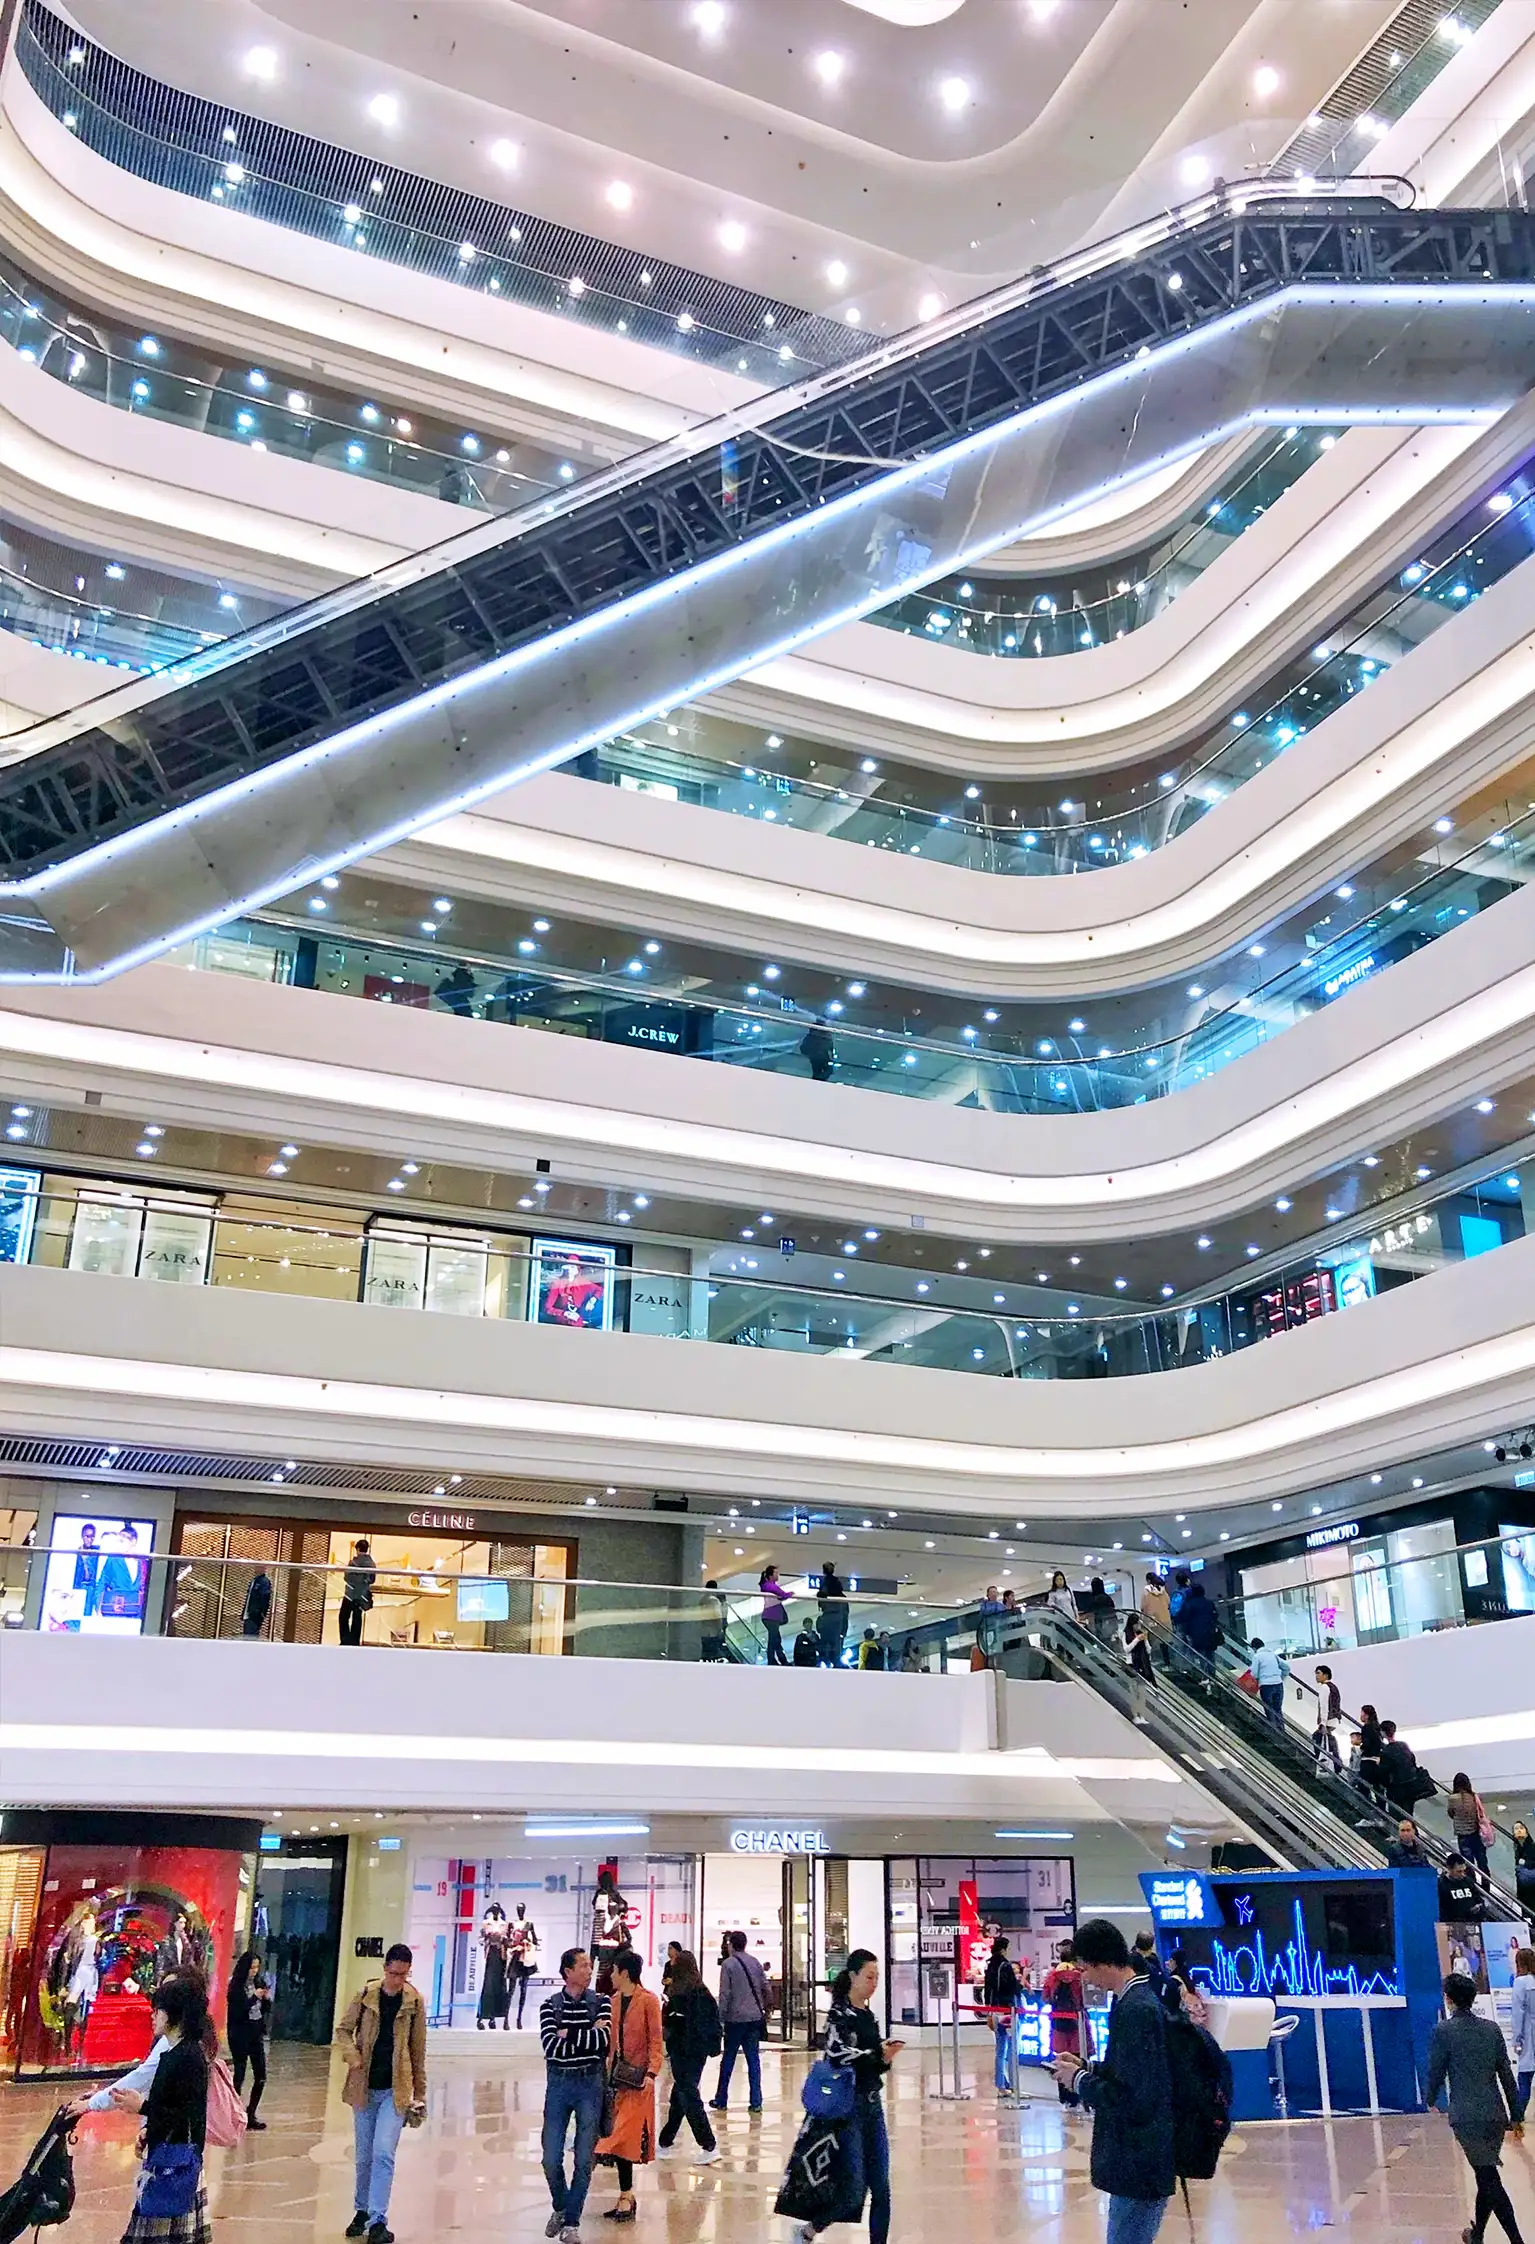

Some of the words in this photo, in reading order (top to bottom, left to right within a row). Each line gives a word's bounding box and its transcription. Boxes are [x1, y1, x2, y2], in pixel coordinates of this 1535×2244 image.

[627, 1025, 680, 1044] J.CREW
[144, 1249, 201, 1266] ZARA
[366, 1276, 420, 1291] ZARA
[634, 1292, 683, 1308] ZARA
[1306, 1523, 1360, 1548] MIKIMOTO
[731, 1830, 831, 1852] CHANEL
